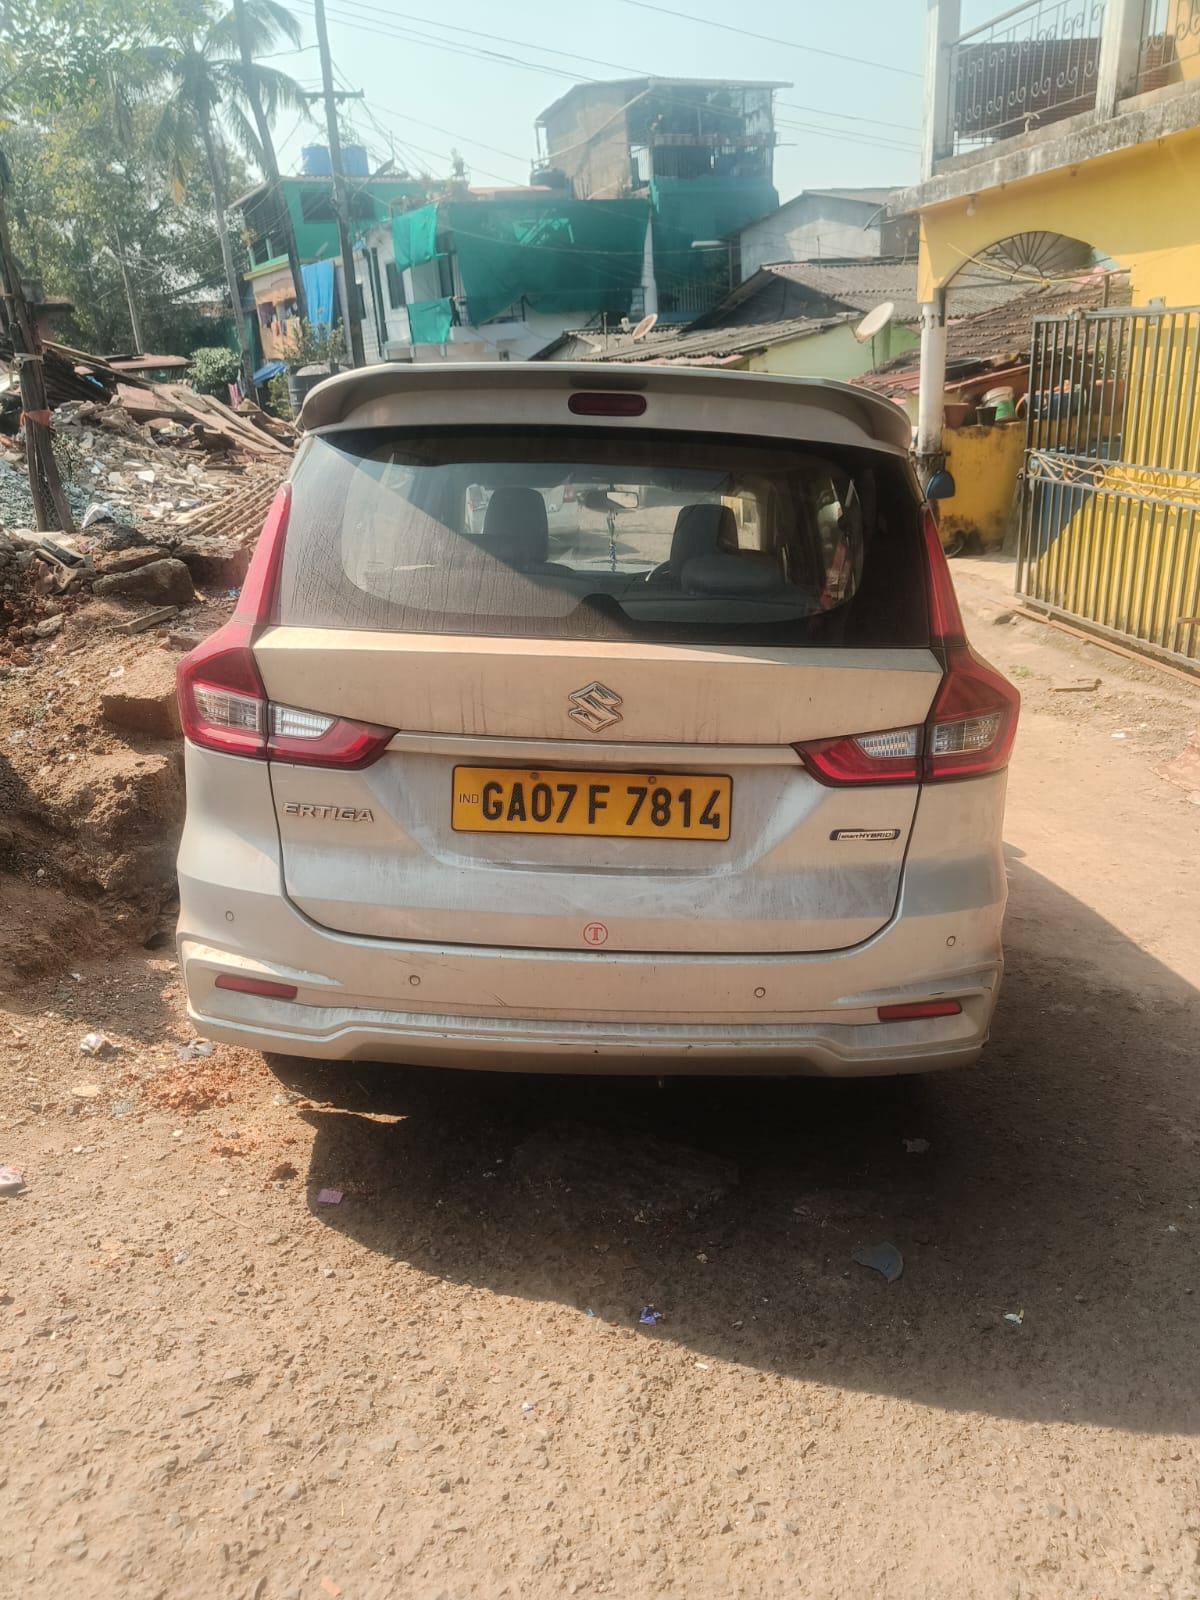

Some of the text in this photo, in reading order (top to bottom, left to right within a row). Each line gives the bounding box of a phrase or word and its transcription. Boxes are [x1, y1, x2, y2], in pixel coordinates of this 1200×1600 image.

[282, 802, 375, 823] ERTIGA
[459, 781, 721, 829] IND GA07 F 7814
